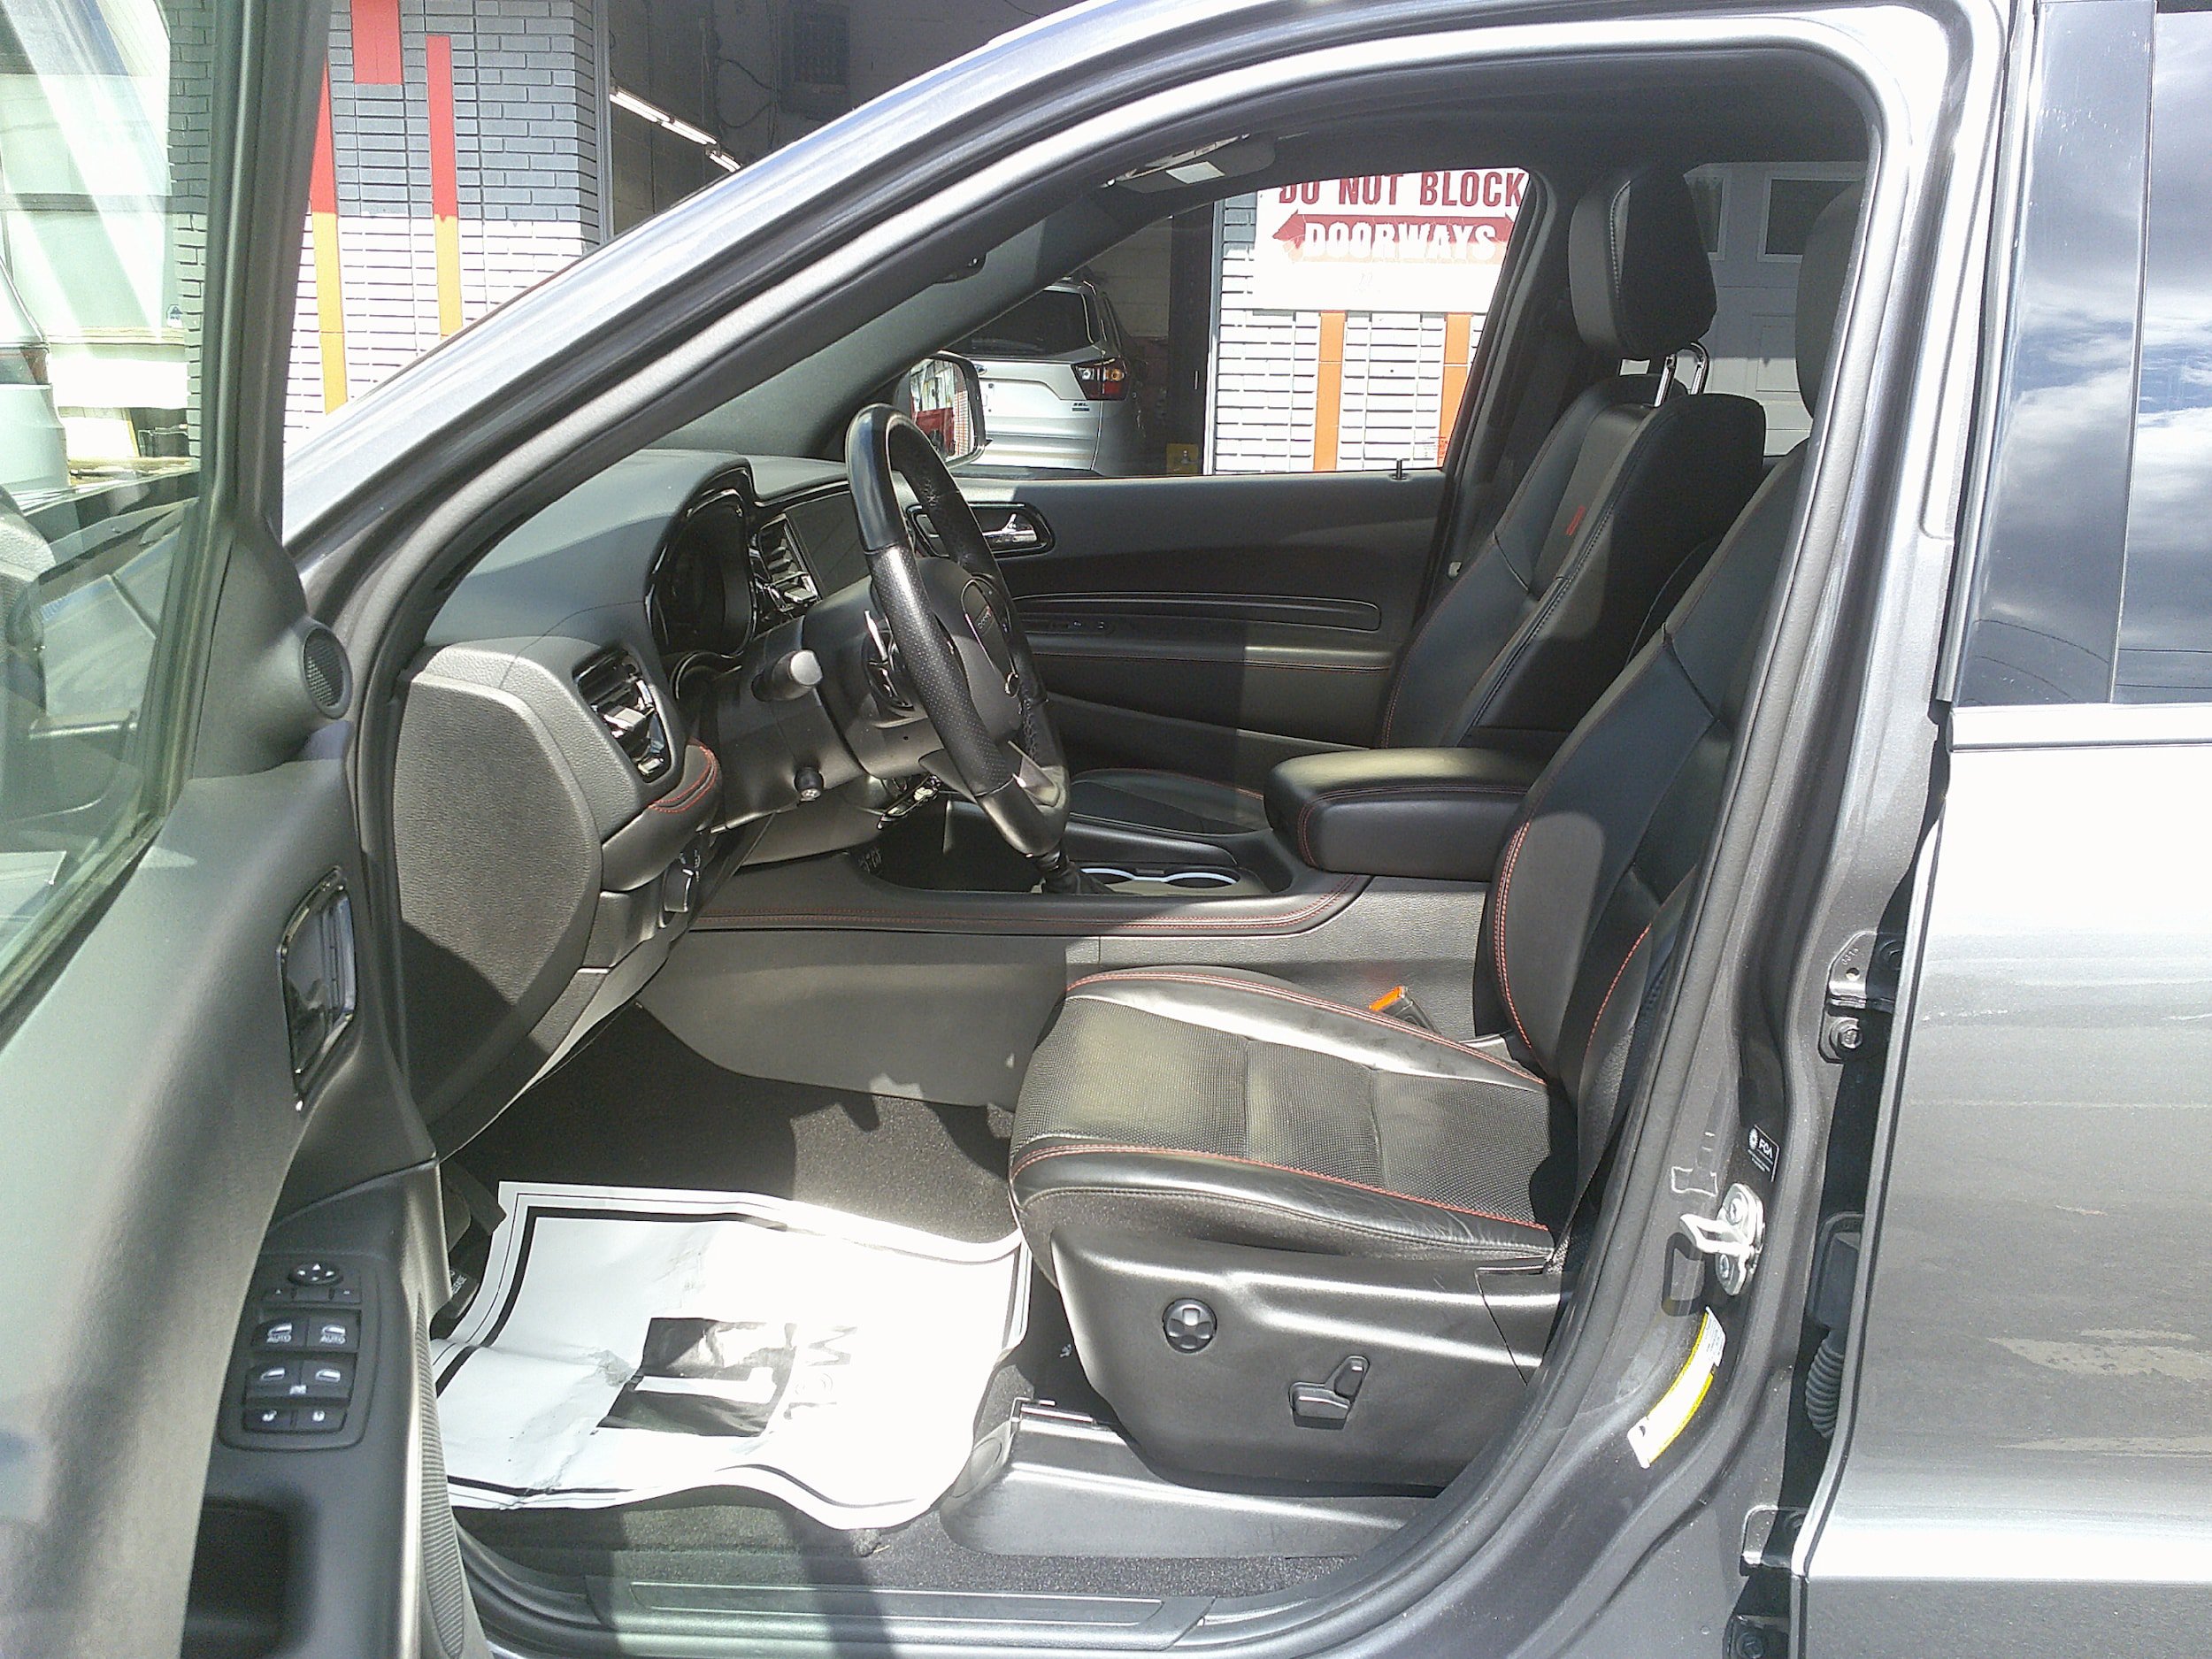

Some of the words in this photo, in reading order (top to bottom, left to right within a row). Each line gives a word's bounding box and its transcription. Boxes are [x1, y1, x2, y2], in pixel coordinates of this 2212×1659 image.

[1279, 182, 1320, 205] DO
[1339, 173, 1403, 206] NOT
[1419, 171, 1526, 207] BLOCK
[1305, 221, 1497, 261] DOORWAYS
[1758, 1137, 1773, 1159] FCA
[266, 1334, 292, 1343] AUTO
[320, 1335, 346, 1344] AUTO
